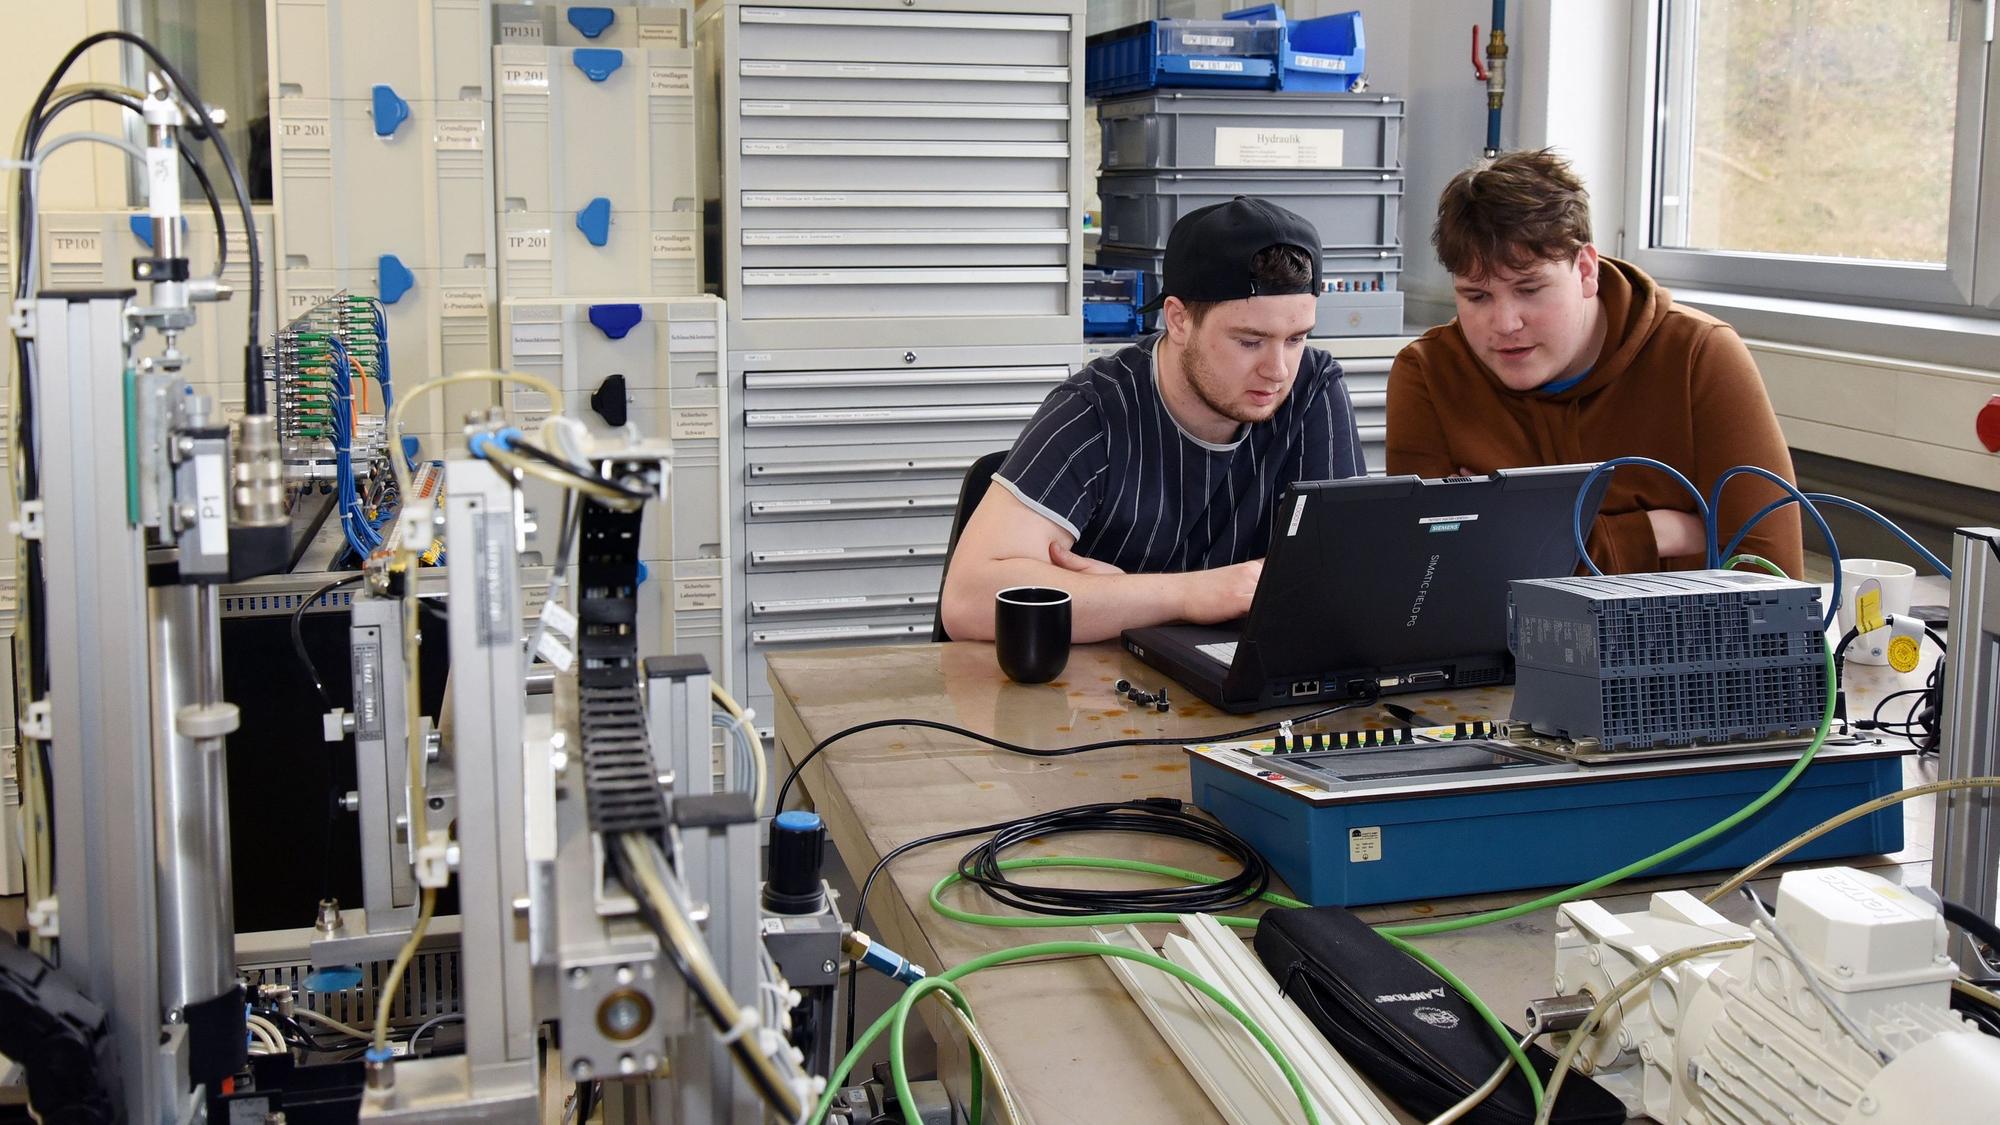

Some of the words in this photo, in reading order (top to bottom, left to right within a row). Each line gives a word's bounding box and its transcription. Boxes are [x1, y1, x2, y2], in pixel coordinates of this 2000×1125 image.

[502, 27, 541, 37] TP1311
[504, 71, 521, 81] TP
[524, 71, 543, 81] 201
[653, 72, 688, 80] Grundlagen
[284, 125, 301, 136] TP
[304, 125, 325, 136] 201
[1256, 133, 1301, 145] Hydraulik
[56, 238, 95, 249] TP101
[508, 236, 525, 248] TP
[527, 236, 547, 248] 201
[290, 295, 307, 306] TP
[444, 292, 482, 300] Grundlagen
[1431, 524, 1460, 532] SIEMENS
[1420, 554, 1440, 589] SIMATIC
[1411, 590, 1427, 614] FIELD
[1406, 615, 1418, 627] PG
